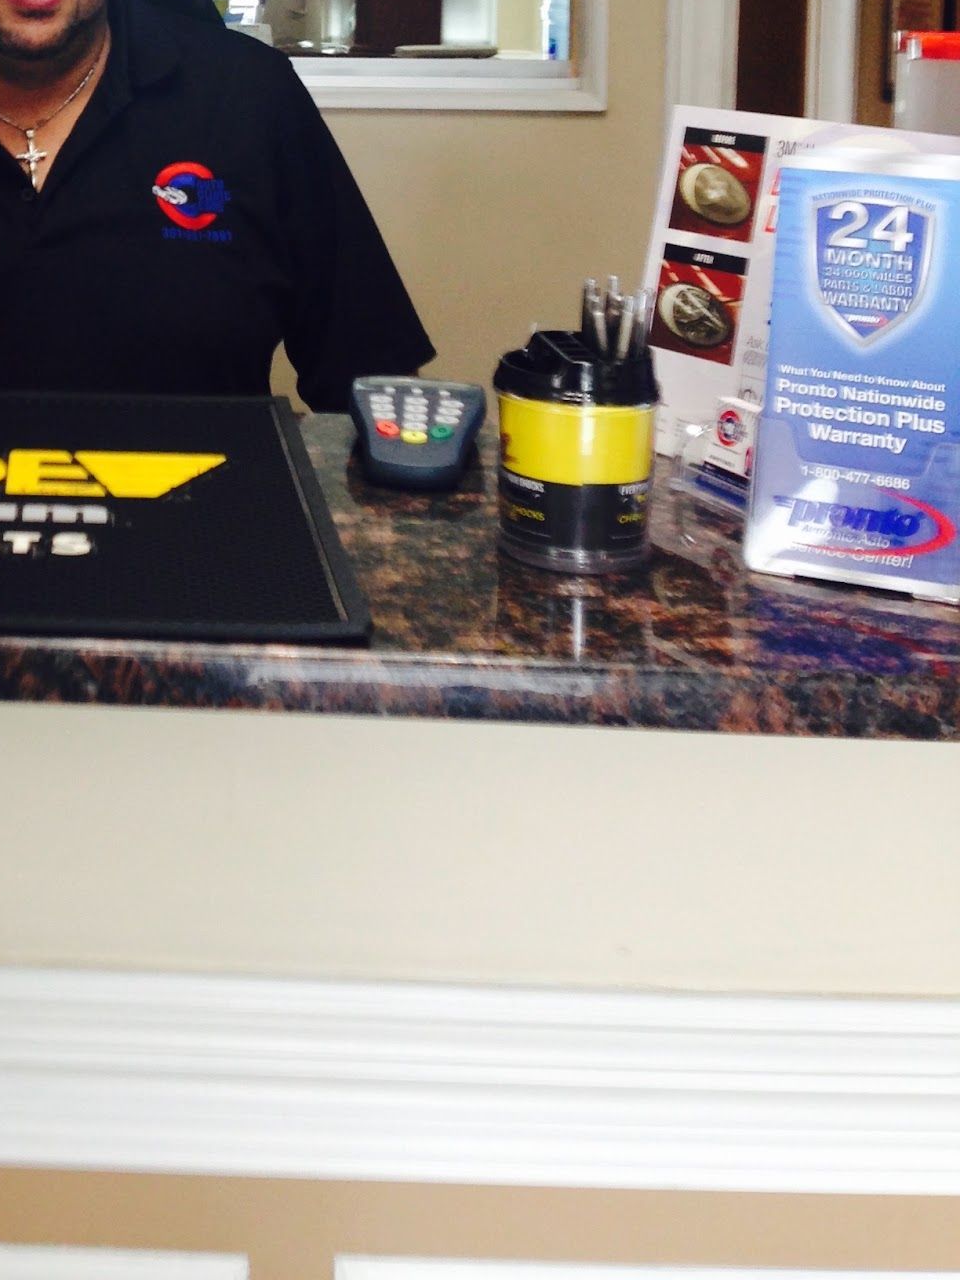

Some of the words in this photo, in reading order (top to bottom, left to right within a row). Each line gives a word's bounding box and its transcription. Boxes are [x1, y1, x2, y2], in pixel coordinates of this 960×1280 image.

[776, 140, 798, 158] 3M
[864, 188, 914, 204] PROTECTION
[827, 201, 914, 252] 24
[824, 248, 913, 272] MONTH
[823, 290, 913, 314] WARRANTY
[778, 363, 808, 377] What
[810, 367, 831, 380] You
[833, 370, 862, 383] Need
[864, 374, 875, 384] to
[877, 376, 909, 389] Know
[911, 379, 946, 393] About
[776, 377, 839, 399] Pronto
[841, 385, 946, 412] Nationwide
[775, 395, 891, 427] Protection
[894, 410, 946, 434] Plus
[807, 422, 907, 454] Warranty
